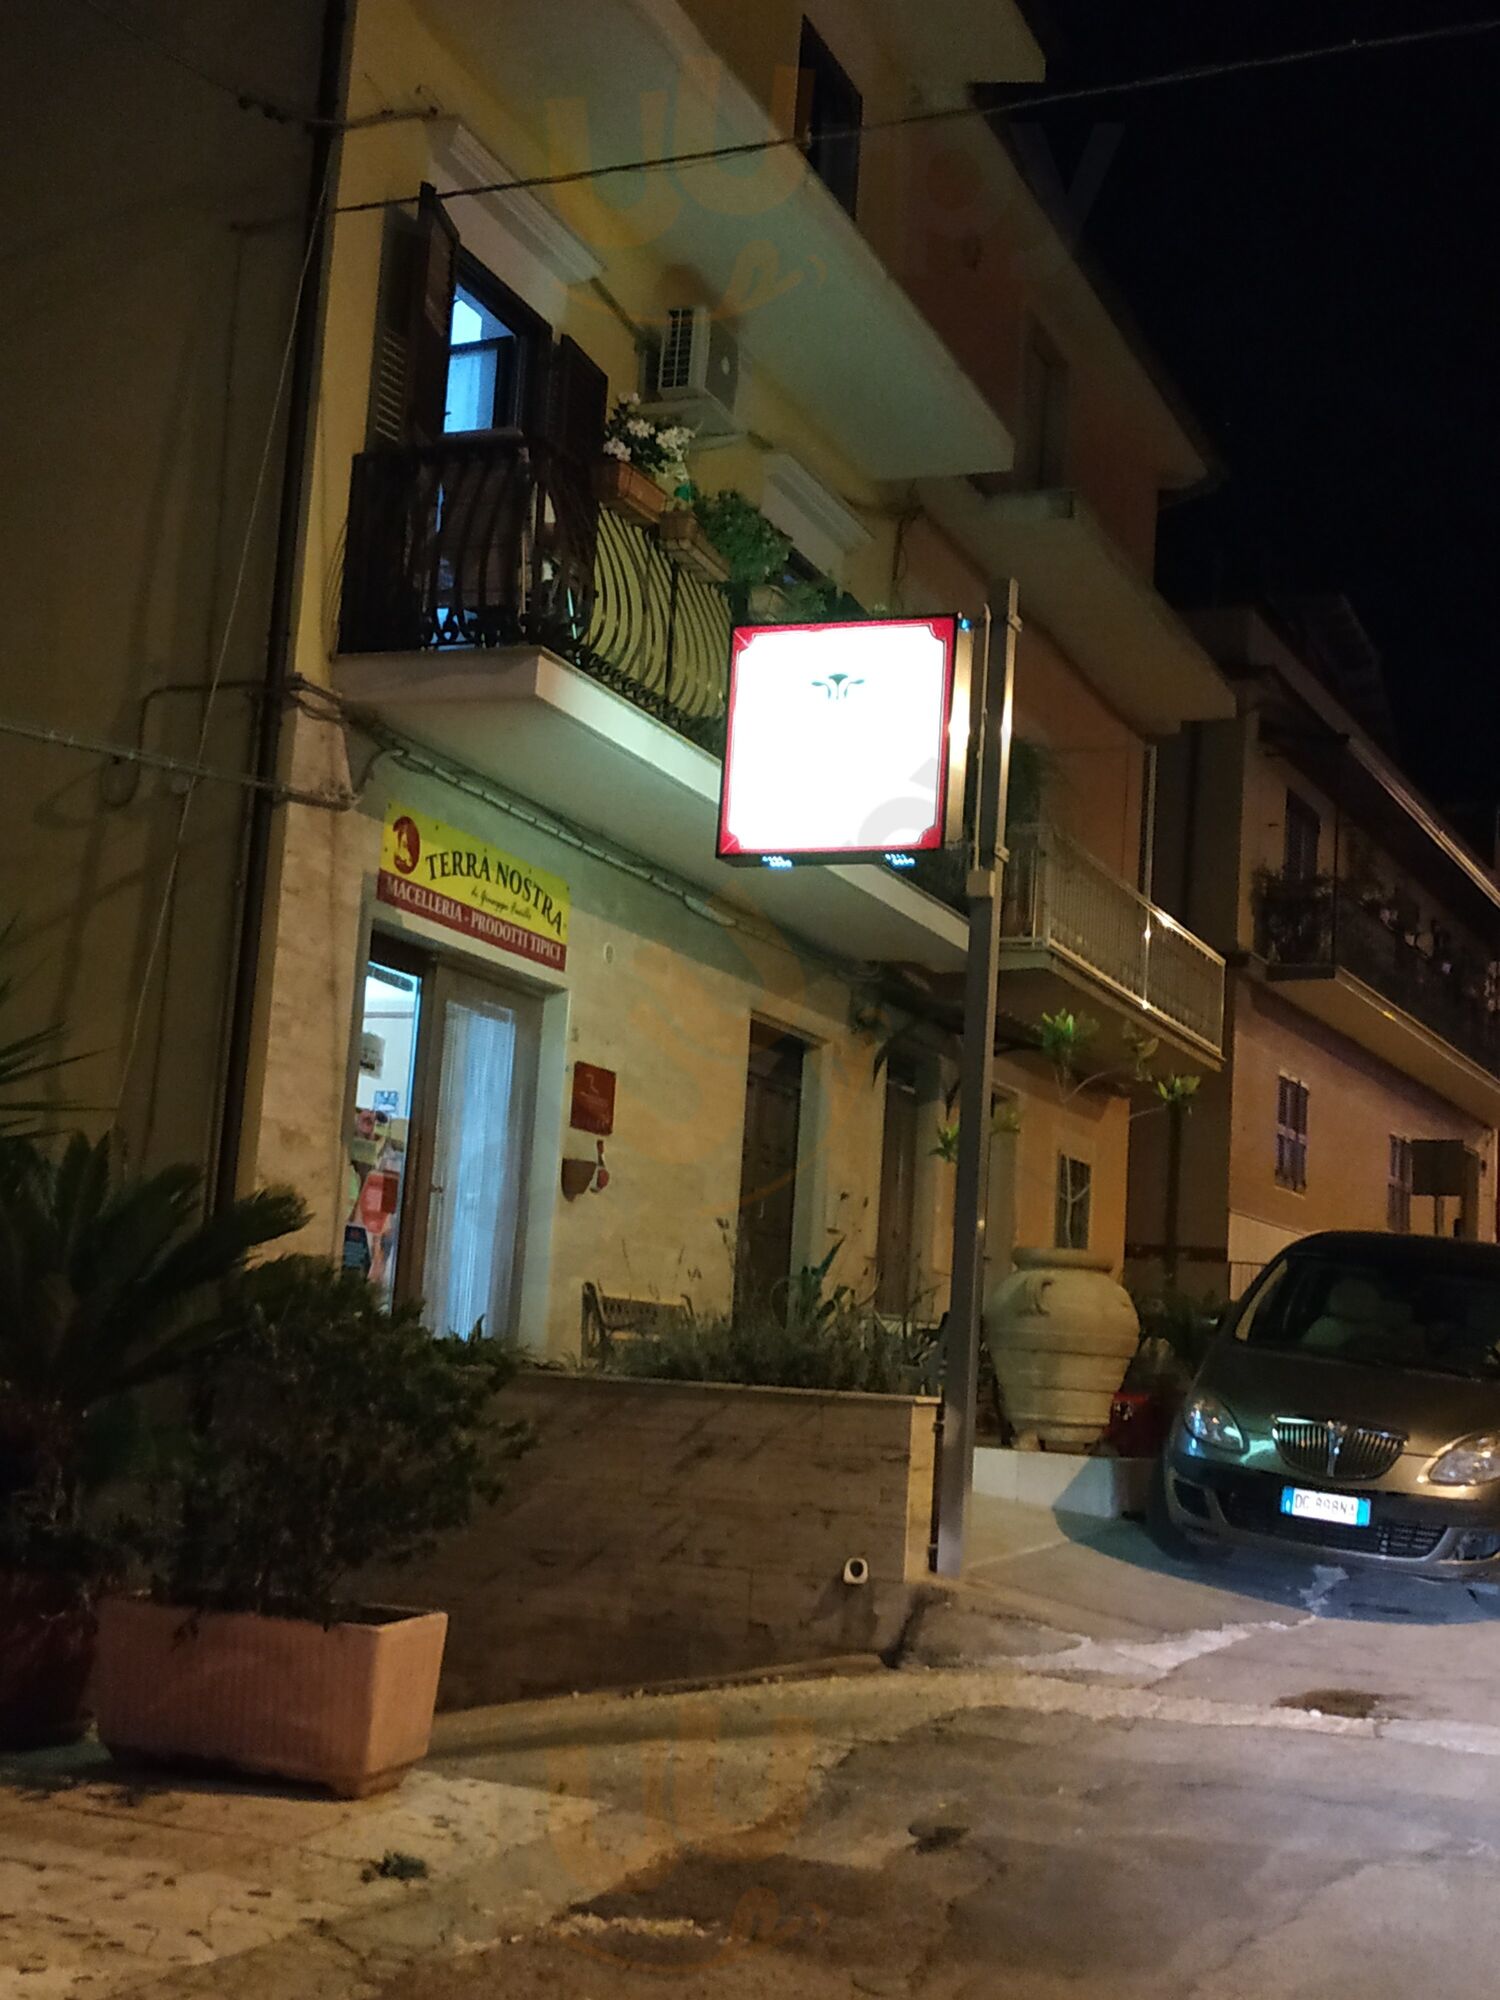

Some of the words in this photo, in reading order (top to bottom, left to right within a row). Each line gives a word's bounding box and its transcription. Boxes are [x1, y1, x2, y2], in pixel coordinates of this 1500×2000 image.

[387, 875, 463, 923] MACELLERIA
[470, 911, 529, 951] PRODOTTI
[529, 934, 562, 961] TIPICI
[425, 850, 491, 882] TERRA
[495, 860, 562, 936] NOSTRA
